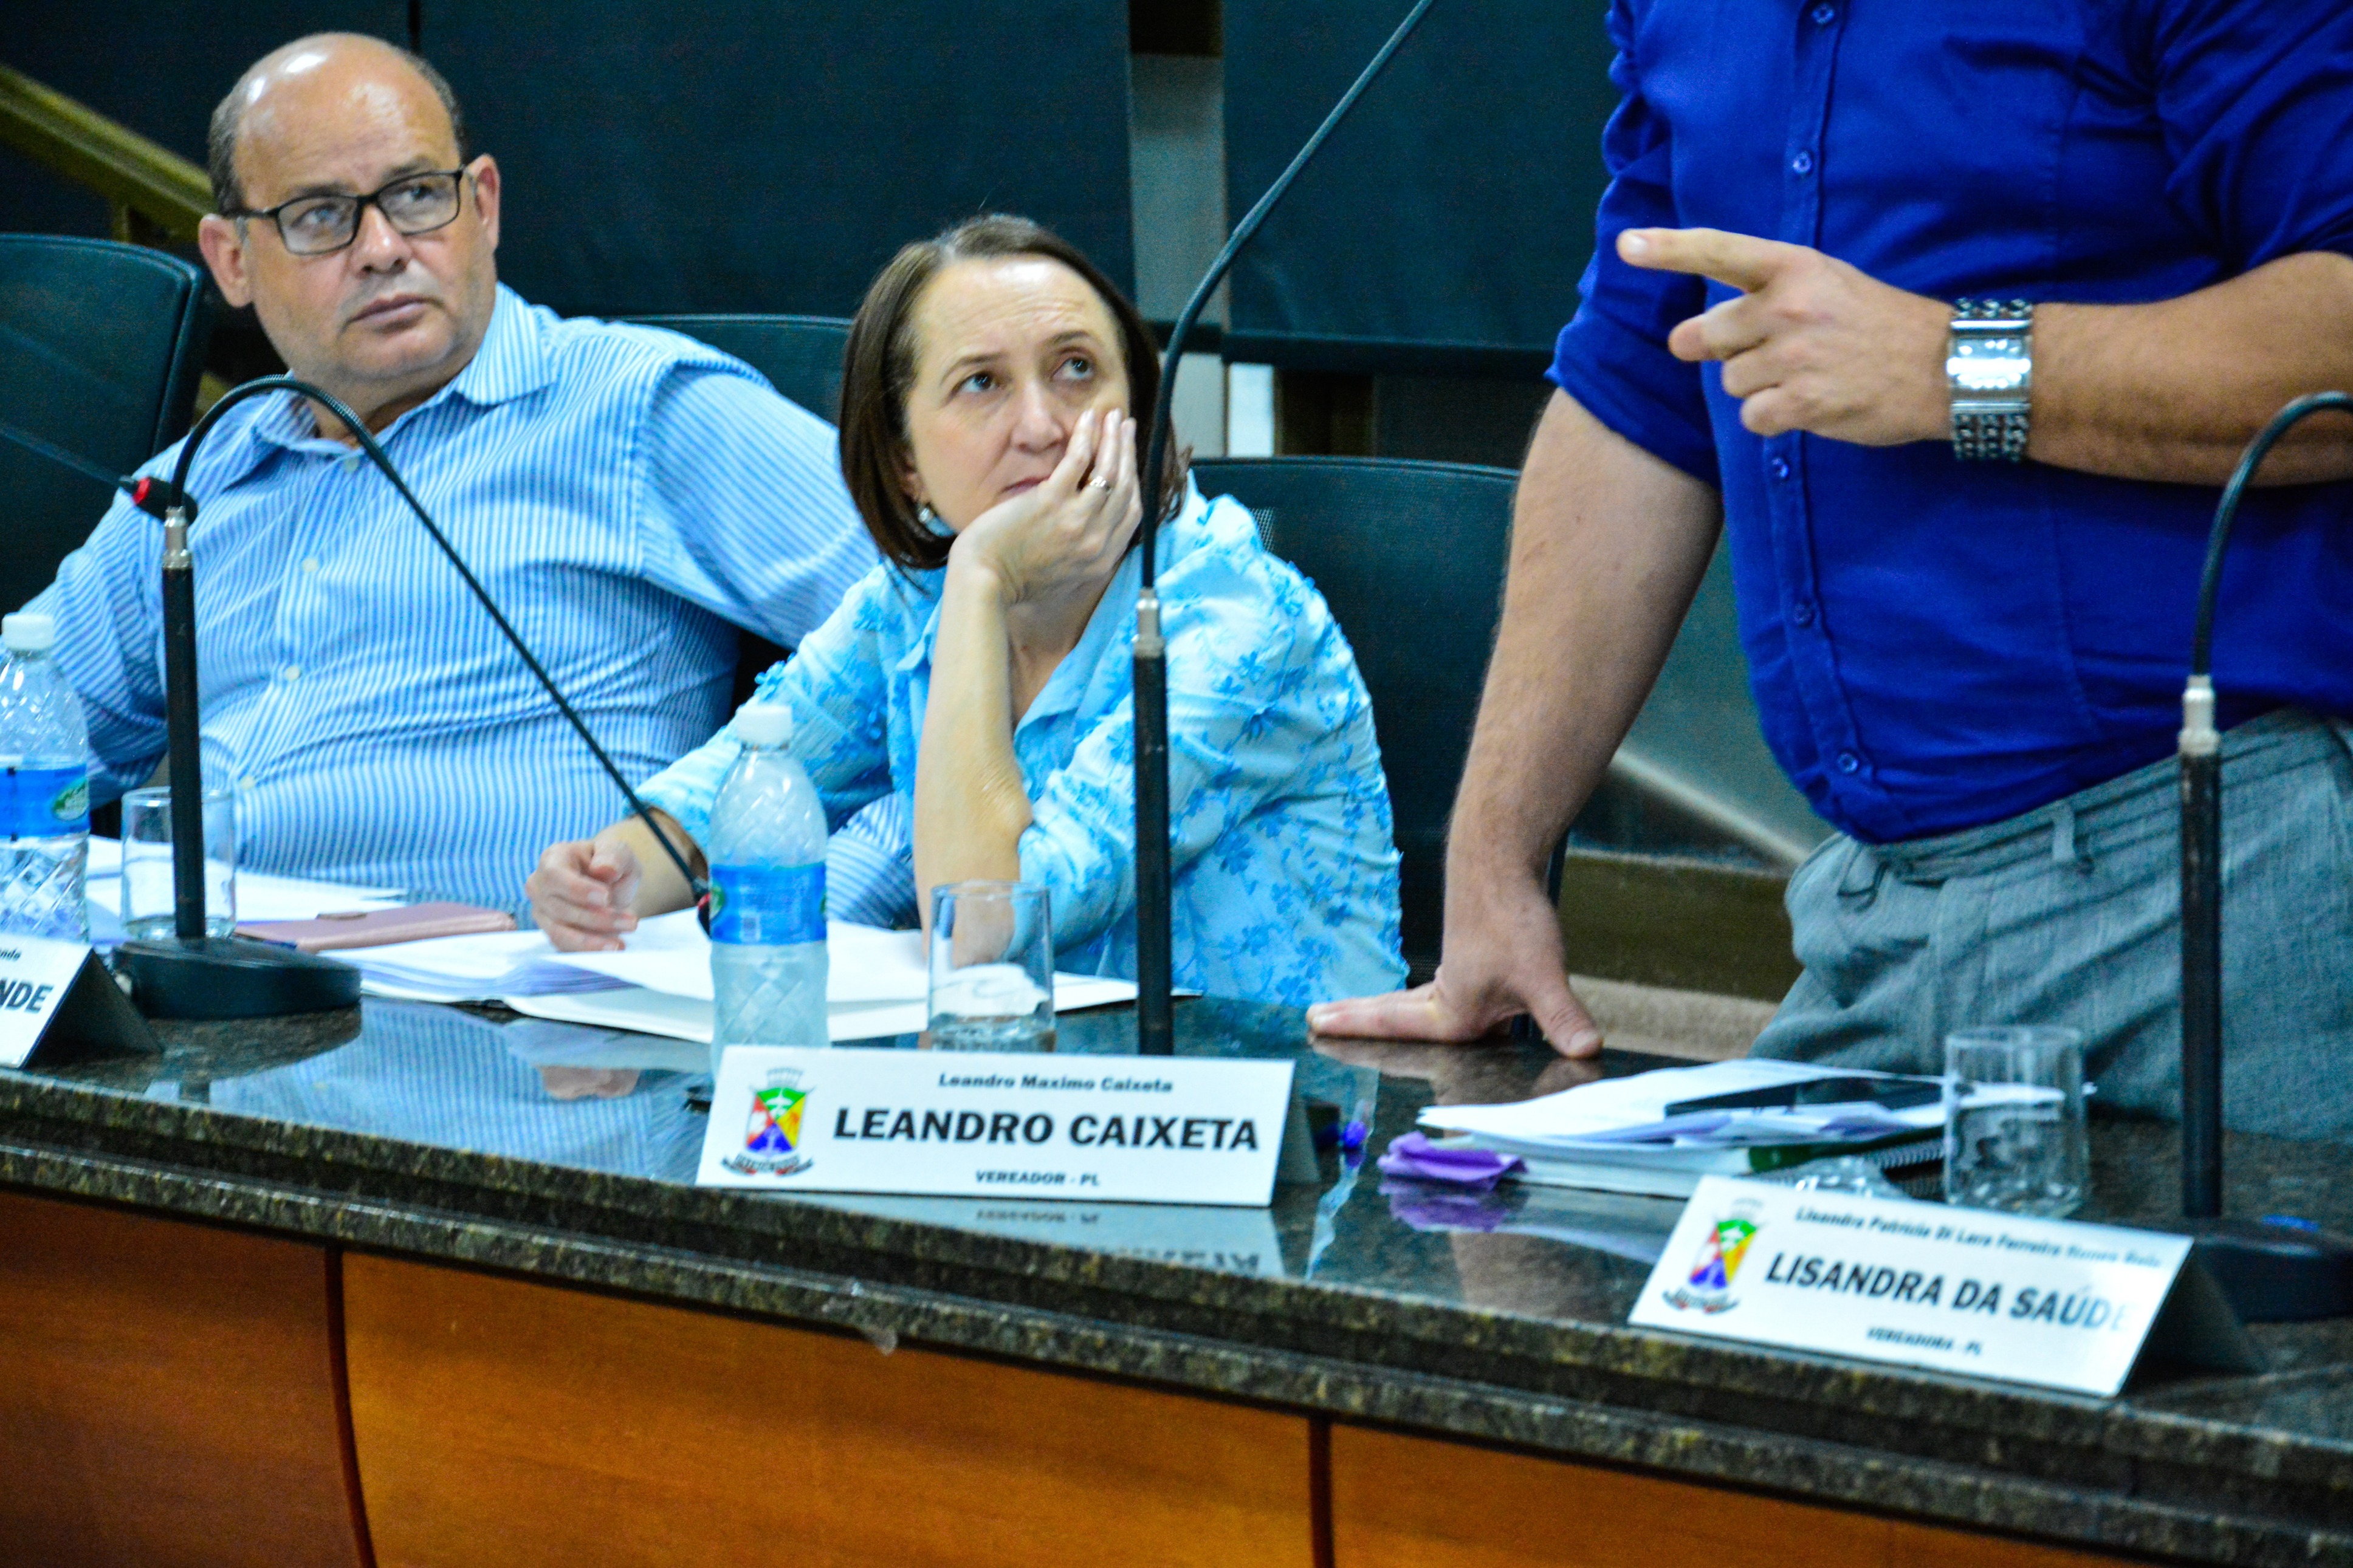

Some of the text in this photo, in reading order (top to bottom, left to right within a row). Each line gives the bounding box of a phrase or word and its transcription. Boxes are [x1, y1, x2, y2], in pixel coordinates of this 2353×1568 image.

[938, 1072, 1173, 1092] Leandro Maximo Caixeta
[834, 1108, 1257, 1151] LEANDRO CAIXETA
[975, 1170, 1066, 1184] VEREADOR
[1079, 1173, 1099, 1186] PL
[1765, 1251, 1943, 1307] LISANDRA
[1951, 1278, 2003, 1315] DA
